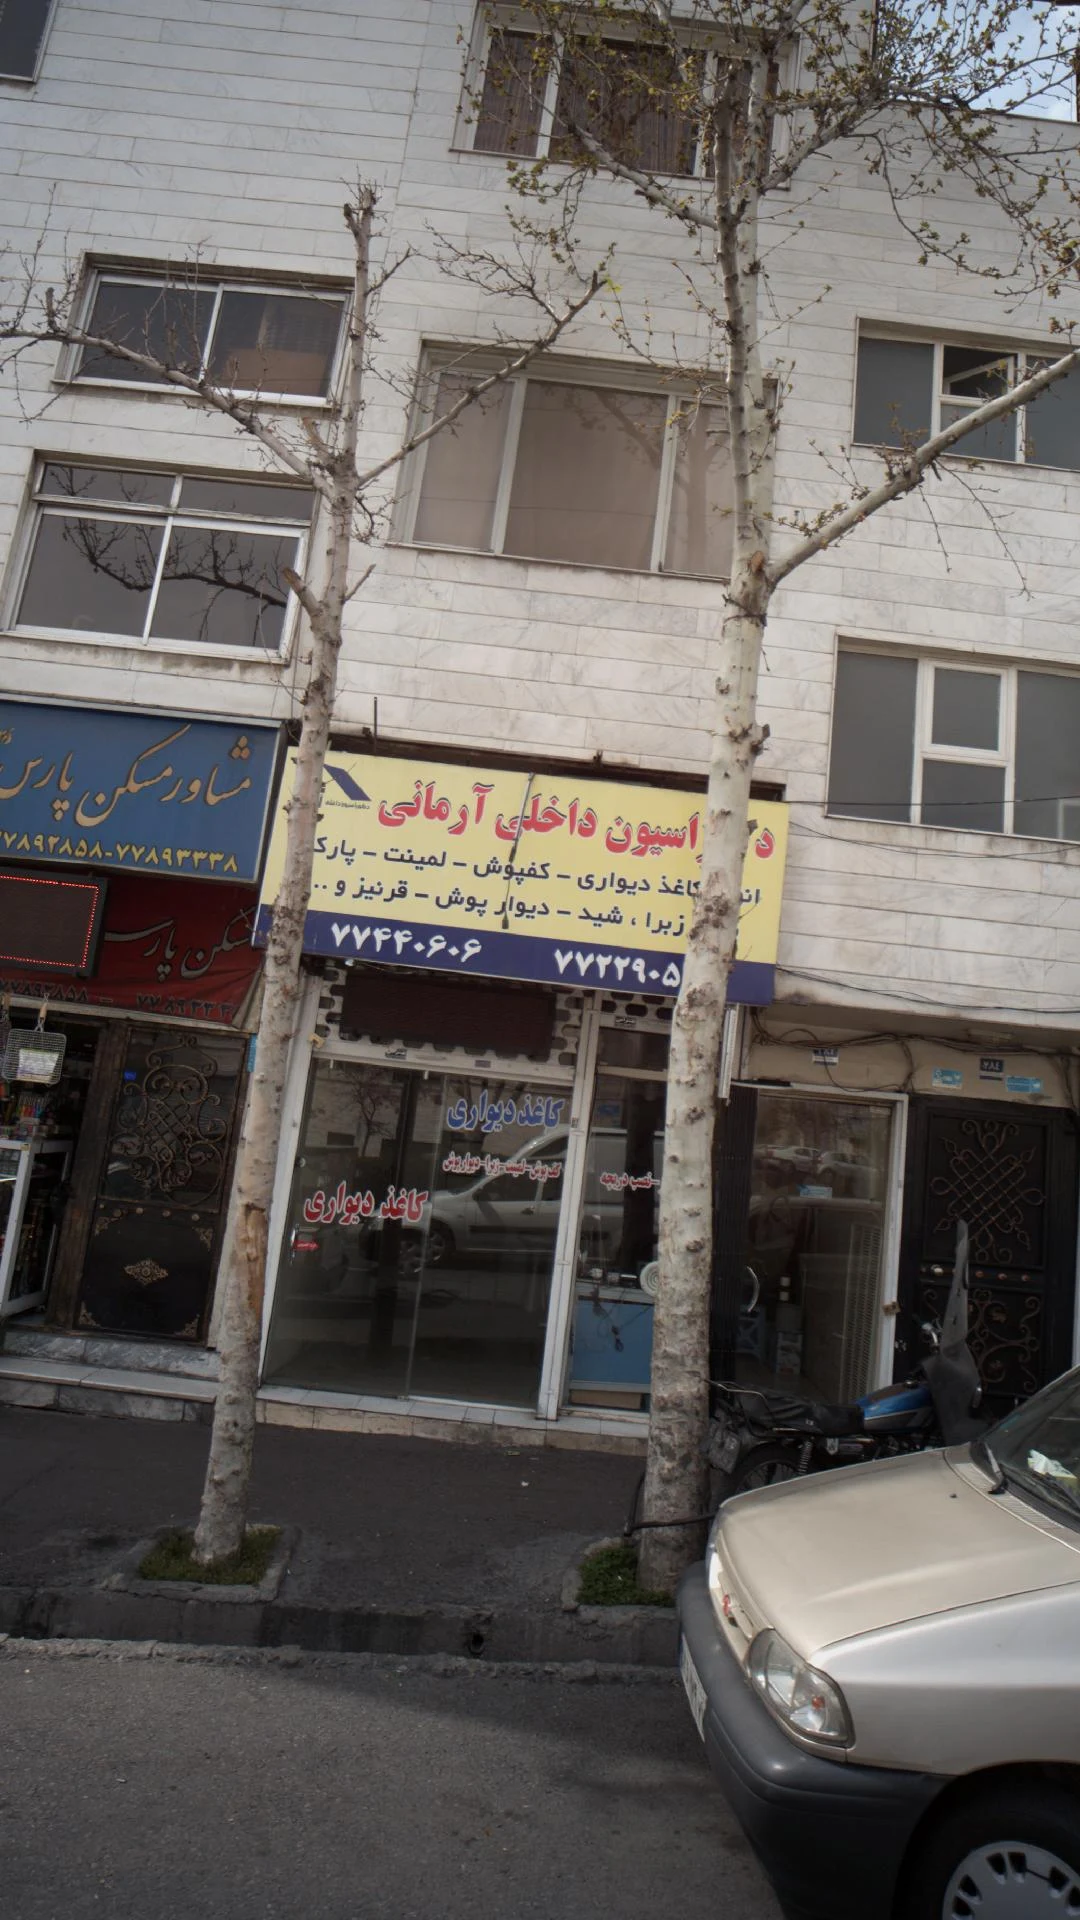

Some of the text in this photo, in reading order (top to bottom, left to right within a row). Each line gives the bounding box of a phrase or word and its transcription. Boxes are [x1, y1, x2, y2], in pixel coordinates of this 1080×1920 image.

[74, 723, 192, 827] مسکن
[159, 735, 251, 805] مشاور
[377, 779, 776, 864] داسیون داخلی آرمانی
[313, 836, 356, 865] پارک
[384, 848, 447, 871] لمینت
[352, 877, 408, 902] قرنیز
[577, 872, 651, 896] دیواری
[578, 906, 623, 928] شید
[180, 907, 254, 979] سکن
[331, 922, 681, 988] ۷۷۲۲۹۰۵ ۷۷۴۴۰۶۰۶
[447, 1089, 565, 1132] کاغذ دیواری
[304, 1180, 429, 1225] کاغذ دیواری
